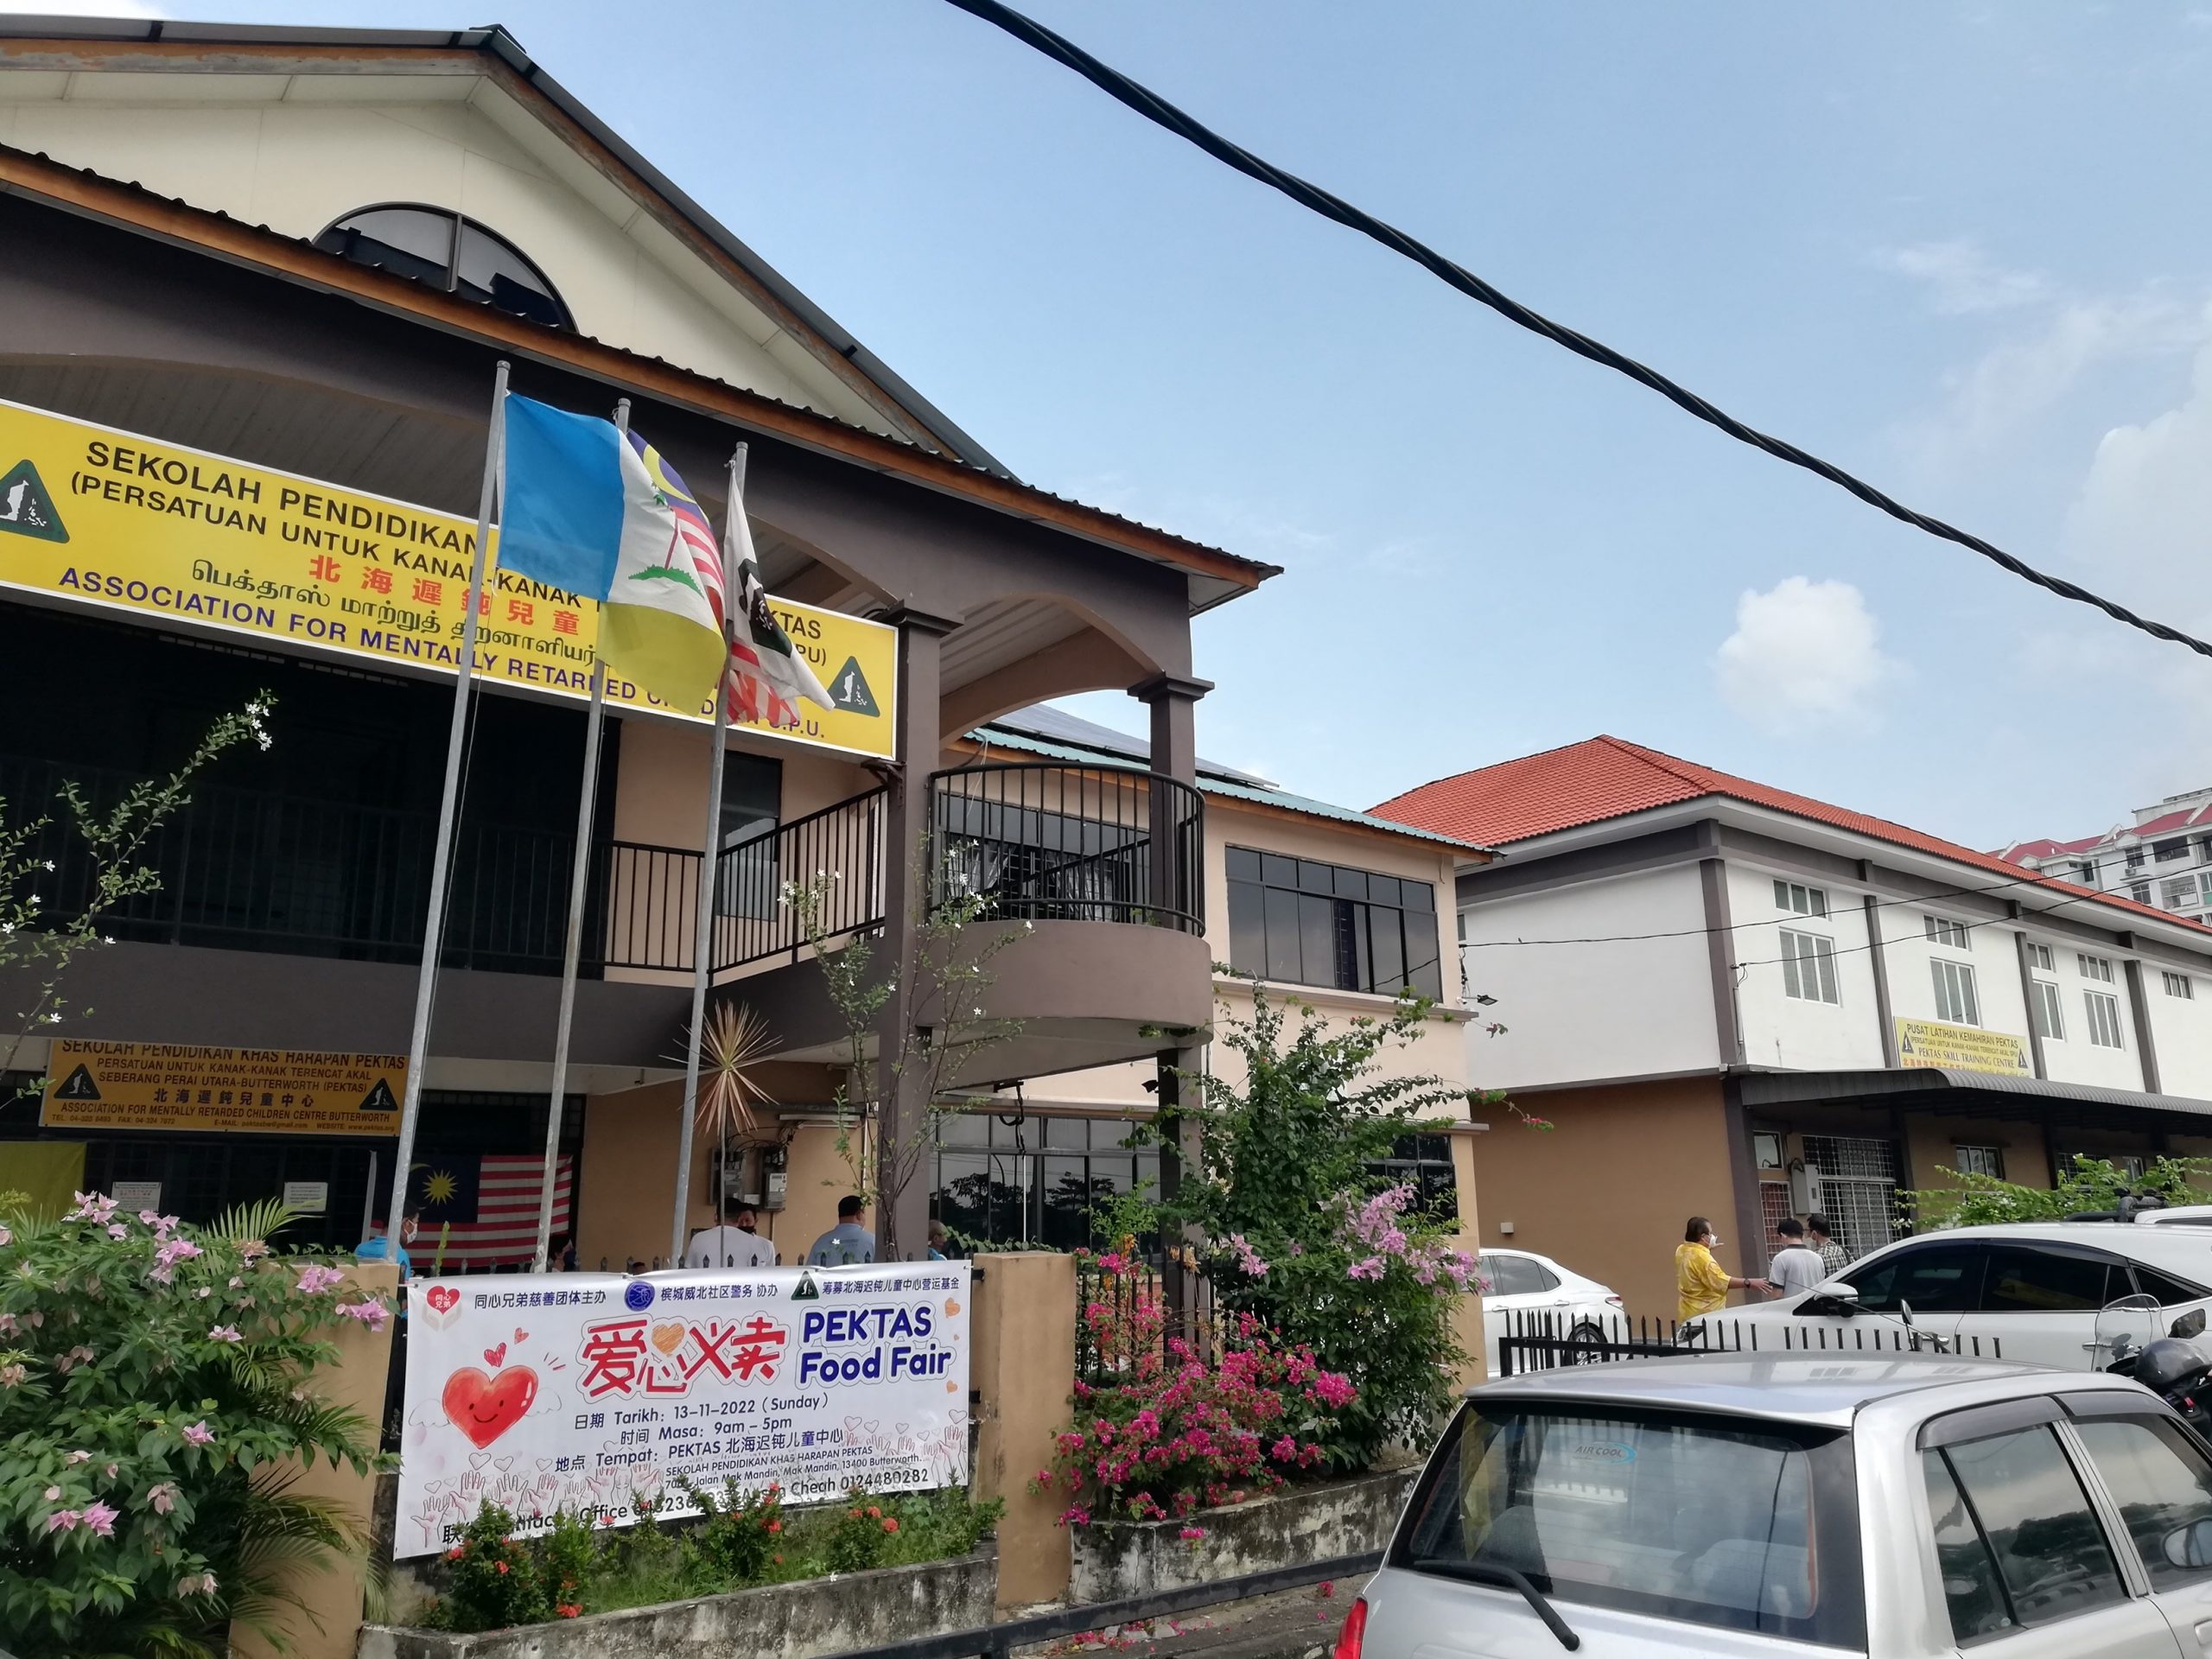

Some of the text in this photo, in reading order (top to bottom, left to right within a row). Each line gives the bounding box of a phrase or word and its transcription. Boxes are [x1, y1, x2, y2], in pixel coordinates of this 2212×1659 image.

[86, 441, 476, 555] SEKOLAH PENDIDIKAN
[71, 471, 266, 535] (PERSATUAN
[282, 520, 379, 562] UNTUK
[59, 568, 274, 628] ASSOCIATION
[289, 614, 346, 643] FOR
[359, 627, 498, 671] MENTALLY
[1907, 1023, 2018, 1050] PUSAT LATIHAN KEMAHIRAN PEKTAS
[97, 1058, 372, 1080] PERSATUAN UNTUK KANAK-KANAK TERENCAT AKAL
[240, 1049, 279, 1063] KHAS
[285, 1052, 350, 1066] HARAPAN
[356, 1054, 405, 1069] PEKTAS
[1918, 1047, 1942, 1059] PEKTAS
[1943, 1050, 1960, 1062] SKILL
[1961, 1053, 1992, 1066] TRAINING
[1993, 1057, 2015, 1069] CENTRE
[99, 1071, 367, 1093] SEBERANG PERAI UTARA-BUTTERWORTH (PEKTAS)
[60, 1103, 391, 1122] ASSOCIATION FOR MENTALLY RETARDED CHILDREN CENTRE BUTTERWORTH
[661, 1283, 778, 1302] 槟城威北社区警务 协办
[822, 1277, 959, 1294] 筹募北海迟钝儿童中心营运基金
[474, 1290, 607, 1310] 同心兄弟慈善团体主办
[804, 1306, 931, 1343] PEKTAS
[582, 1315, 785, 1397] 爱心义卖
[800, 1344, 951, 1383] Food Fair
[575, 1412, 604, 1430] 日期
[614, 1407, 664, 1426] Tarikh:
[674, 1400, 755, 1420] 13-11-2022
[620, 1428, 650, 1446] 时间
[658, 1426, 704, 1441] Masa:
[714, 1421, 745, 1435] 9am
[763, 1417, 792, 1433] 5pm
[556, 1428, 843, 1472] 地点 Tempat: PEKTAS 北海迟钝儿童中心
[665, 1446, 873, 1477] SEKOLAH PENDIDIKAN KHAS HARAPAN PEKTAS
[1575, 1446, 1622, 1458] AIR COOL
[695, 1476, 719, 1487] Jalan
[744, 1469, 780, 1481] Mandin,
[784, 1465, 803, 1476] Mak
[805, 1462, 839, 1474] Mandin,
[842, 1459, 867, 1470] 13400
[580, 1503, 627, 1522] Office
[791, 1476, 836, 1497] Cheah
